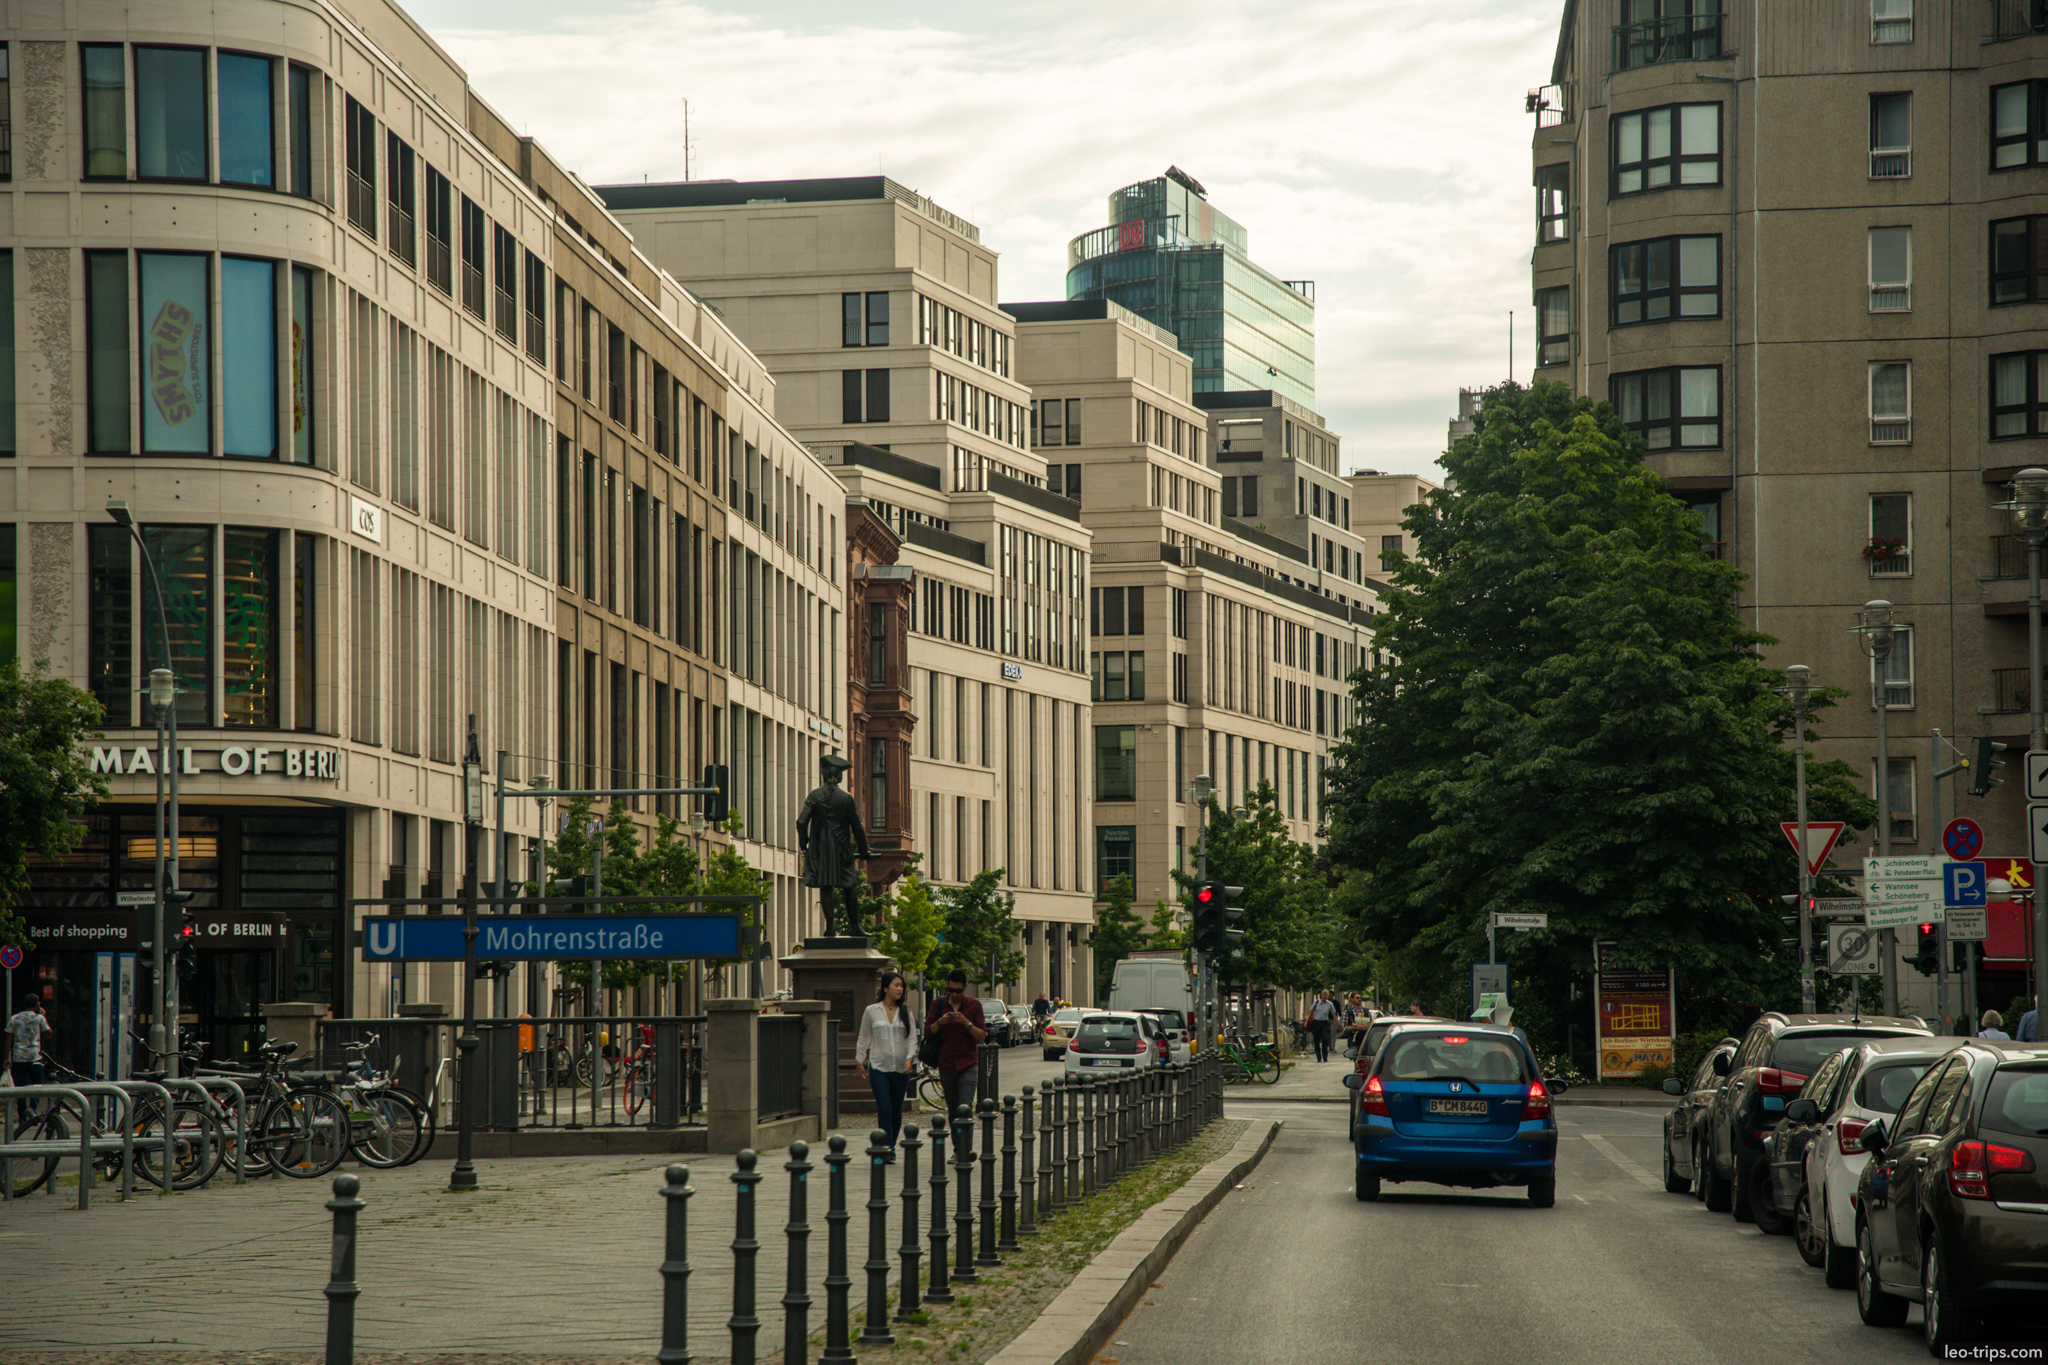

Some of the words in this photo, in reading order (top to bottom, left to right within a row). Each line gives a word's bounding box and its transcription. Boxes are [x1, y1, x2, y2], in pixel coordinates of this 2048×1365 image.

[1122, 225, 1141, 246] DB
[189, 323, 202, 381] SUPERSTORES
[157, 302, 192, 424] SMYTHS
[192, 382, 203, 405] TOYS
[220, 746, 269, 776] OF
[1893, 869, 1922, 877] Potsdamer
[1922, 868, 1936, 876] Platz
[1953, 868, 1976, 901] P
[1885, 892, 1930, 901] Schöneberg
[1878, 904, 1919, 916] Hauptbahnhof
[1504, 916, 1541, 925] Wilhelmstraße
[1870, 916, 1908, 926] Brandenburger
[31, 925, 50, 938] Best
[53, 924, 64, 937] of
[67, 923, 128, 939] shopping
[207, 923, 228, 936] OF
[233, 923, 272, 936] BERLIN
[370, 923, 397, 956] U
[486, 924, 663, 951] Mohrenstraße
[1842, 962, 1867, 971] ZONE
[1633, 1052, 1664, 1062] MAYA
[1430, 1100, 1438, 1111] B
[1444, 1101, 1459, 1111] CM
[1460, 1101, 1486, 1112] 8440
